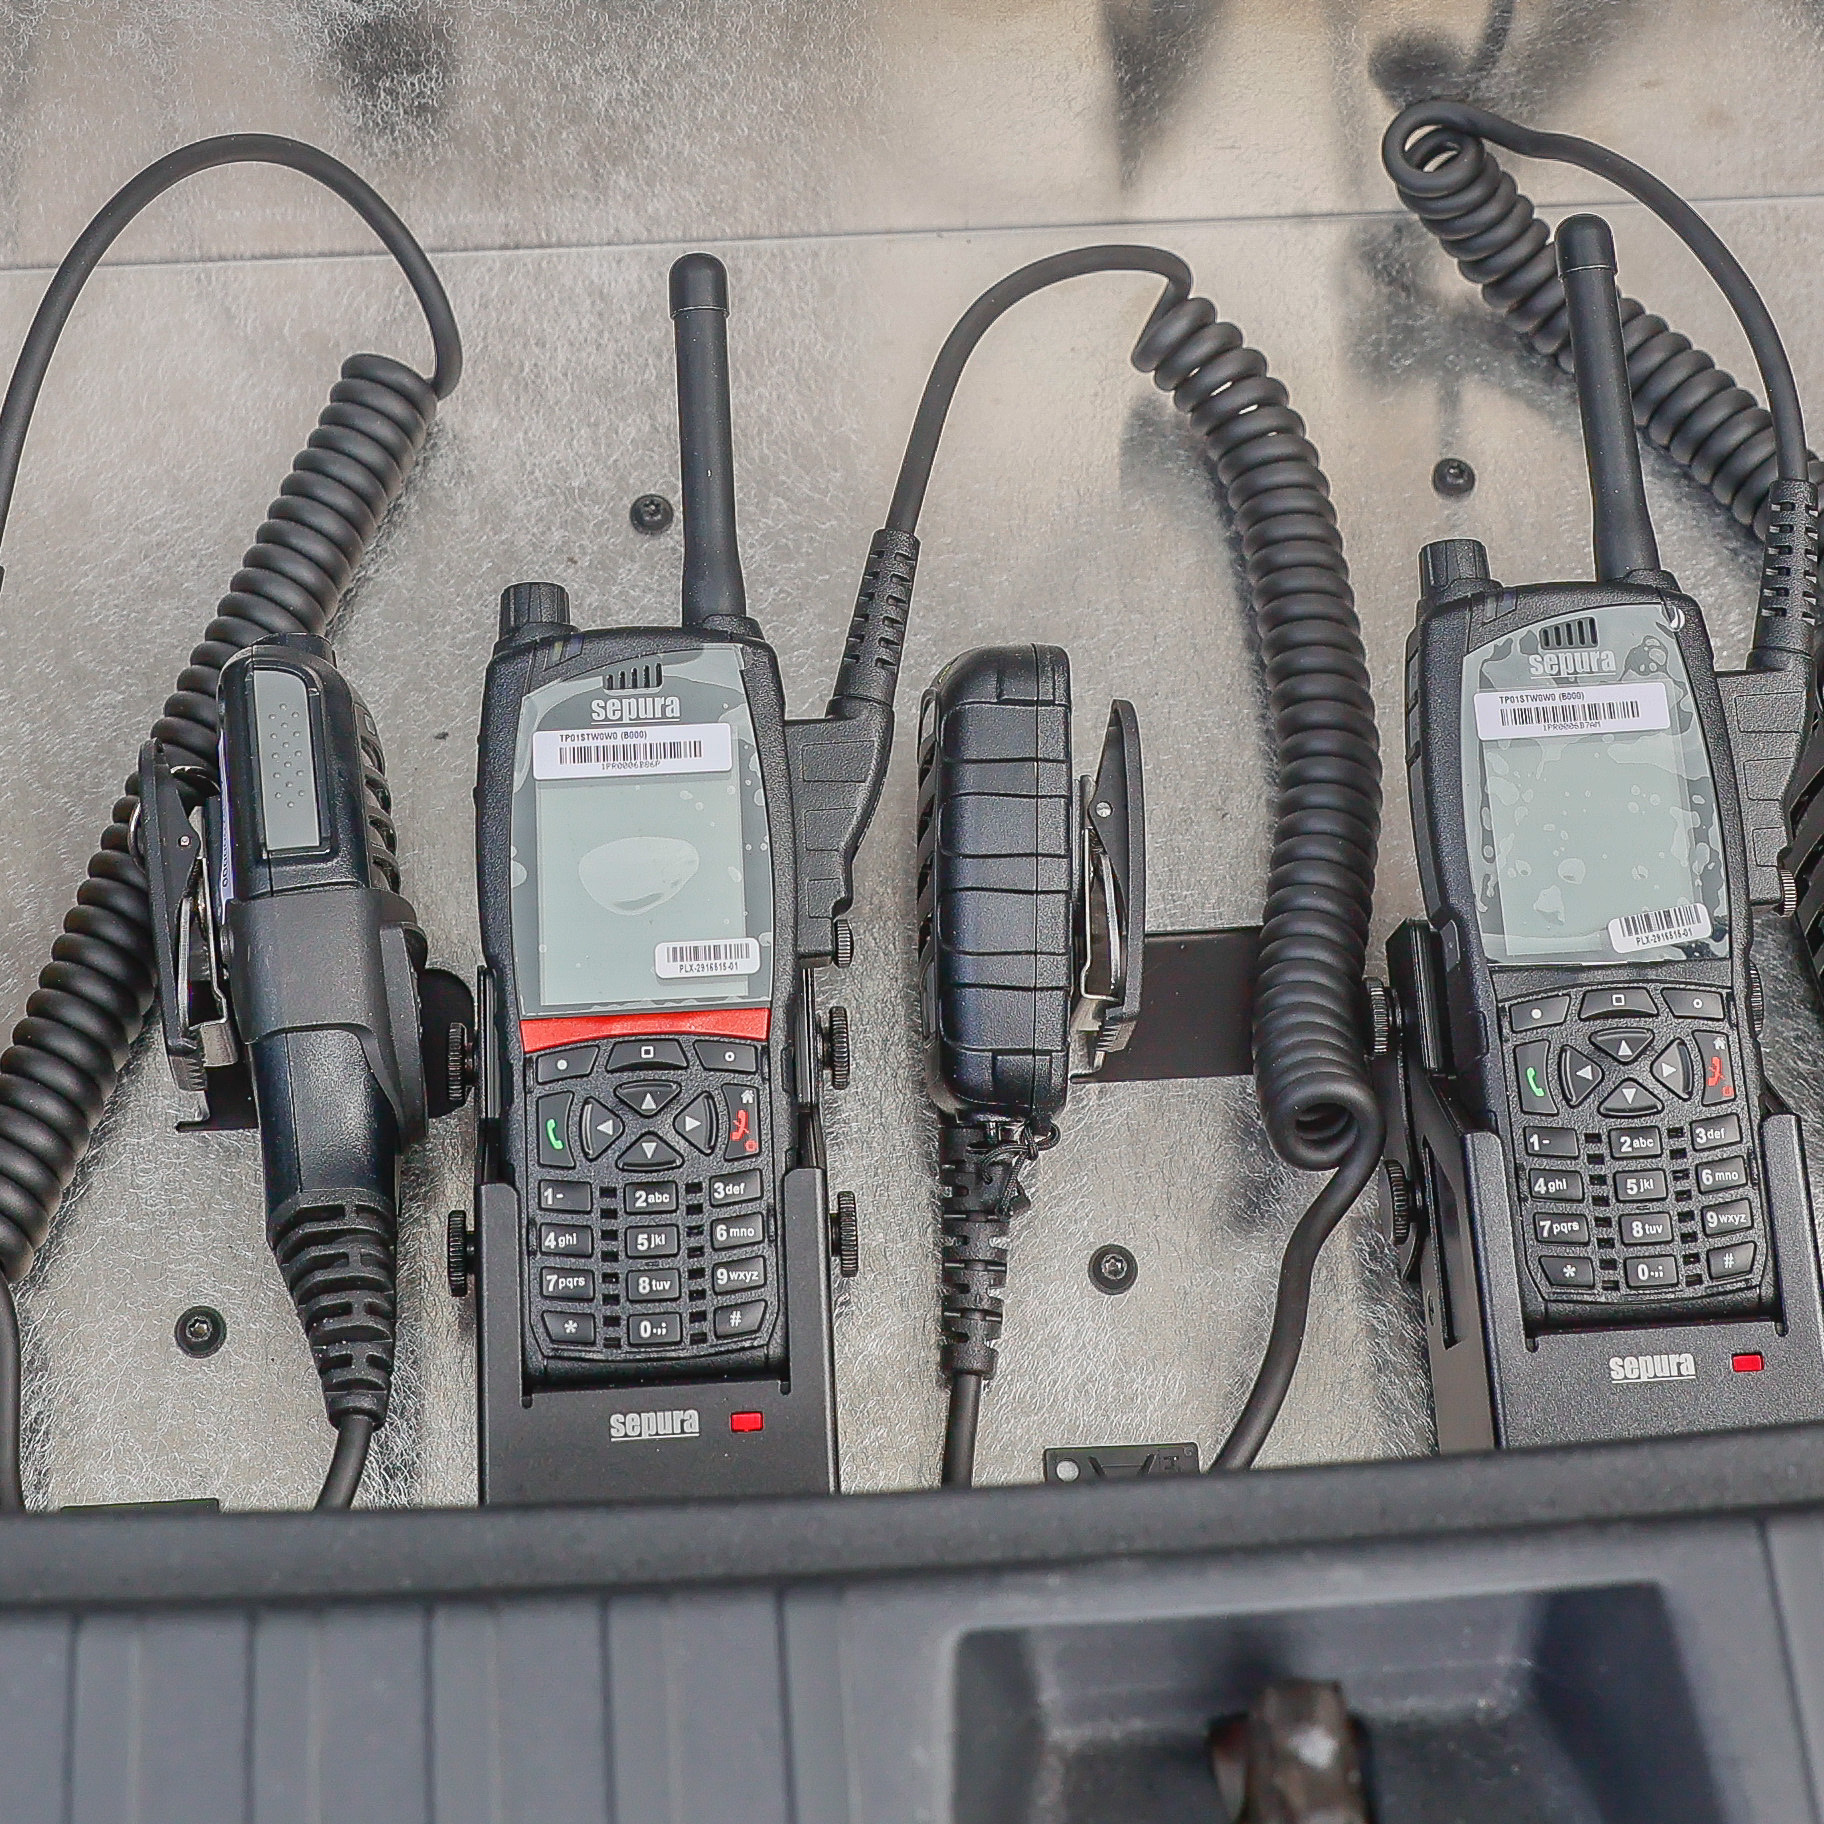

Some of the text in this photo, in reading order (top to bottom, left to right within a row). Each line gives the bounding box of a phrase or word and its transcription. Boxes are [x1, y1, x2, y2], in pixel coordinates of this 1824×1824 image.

[1528, 650, 1616, 679] sepura
[591, 696, 681, 725] sepura
[1636, 928, 1693, 946] PLX-2916515-01
[679, 962, 738, 973] PLX-2916515-01
[1609, 1353, 1696, 1384] sepura
[609, 1409, 700, 1442] sepura
